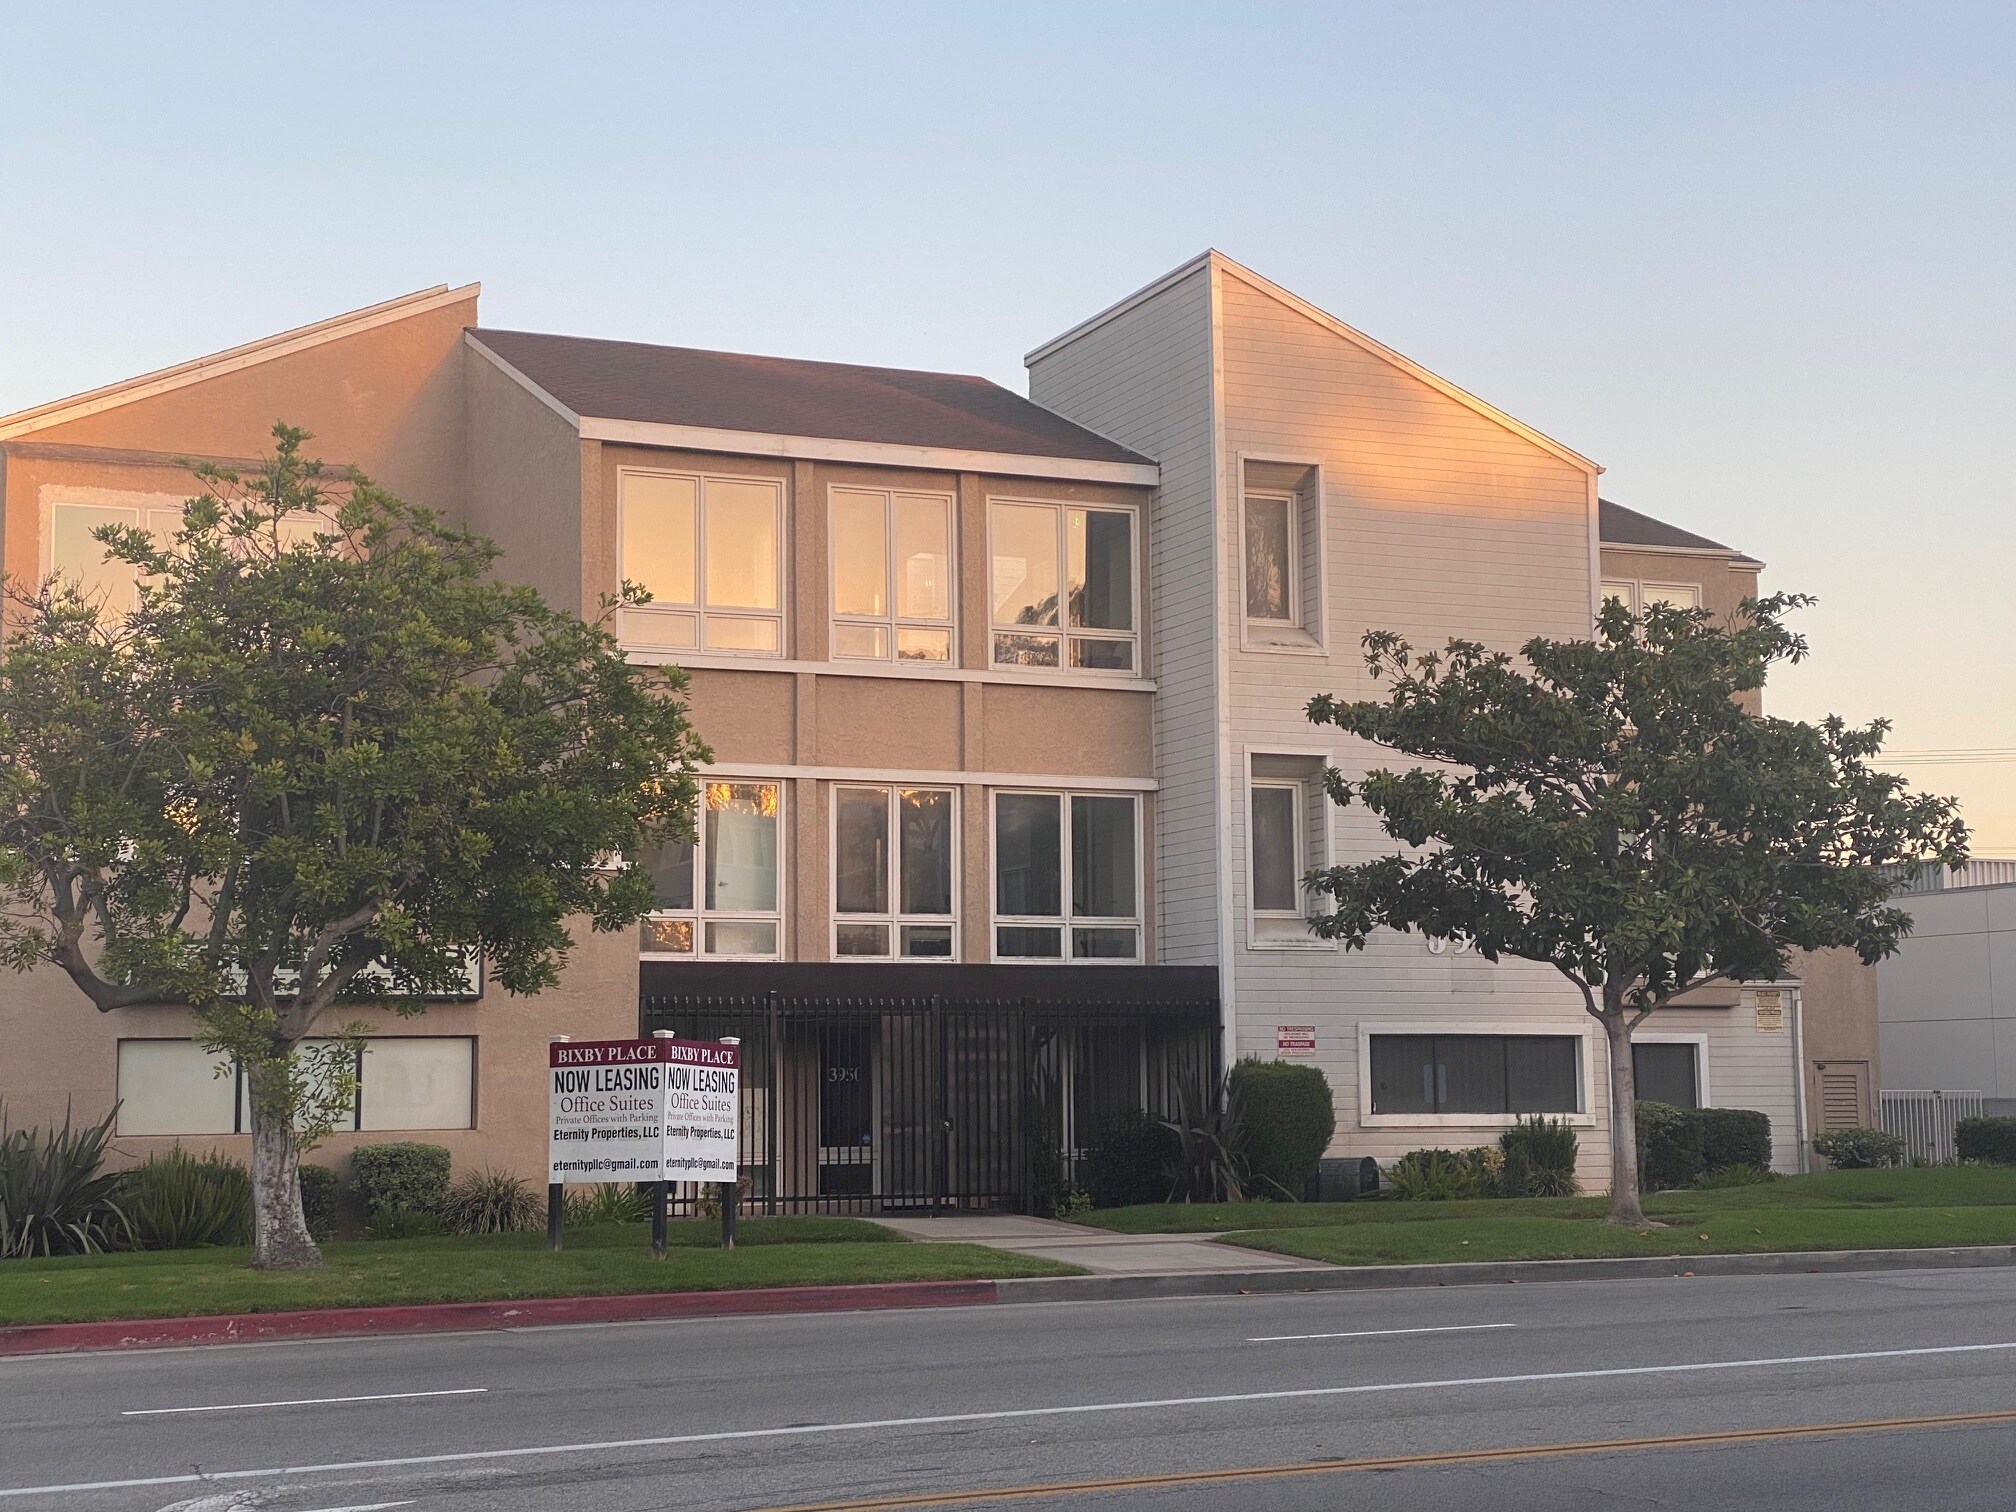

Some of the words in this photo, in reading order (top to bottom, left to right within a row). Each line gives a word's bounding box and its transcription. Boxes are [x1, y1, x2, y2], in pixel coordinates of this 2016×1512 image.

[558, 1048, 605, 1063] BIXBY
[608, 1045, 657, 1061] PLACE
[671, 1045, 699, 1061] BIXBY
[701, 1049, 734, 1065] PLACE
[554, 1070, 590, 1093] NOW
[596, 1066, 659, 1092] LEASING
[668, 1067, 690, 1090] NOW
[693, 1069, 735, 1094] LEASING
[561, 1096, 605, 1113] Office
[609, 1094, 654, 1111] Suites
[671, 1092, 699, 1110] Office
[701, 1094, 731, 1112] Suites
[556, 1115, 581, 1124] Private
[582, 1114, 609, 1124] Offices
[610, 1112, 628, 1123] with
[629, 1112, 659, 1124] Parking
[667, 1111, 684, 1121] Private
[714, 1114, 734, 1126] Parking
[553, 1128, 589, 1142] Eternity
[591, 1126, 642, 1141] Properties,
[643, 1126, 660, 1138] LLC
[666, 1125, 690, 1139] Eternity
[690, 1126, 723, 1141] Properties,
[724, 1128, 735, 1140] LLC
[553, 1158, 659, 1172] eternitypllc@gmail.com
[666, 1157, 735, 1171] eternitypllc@gmail.com
